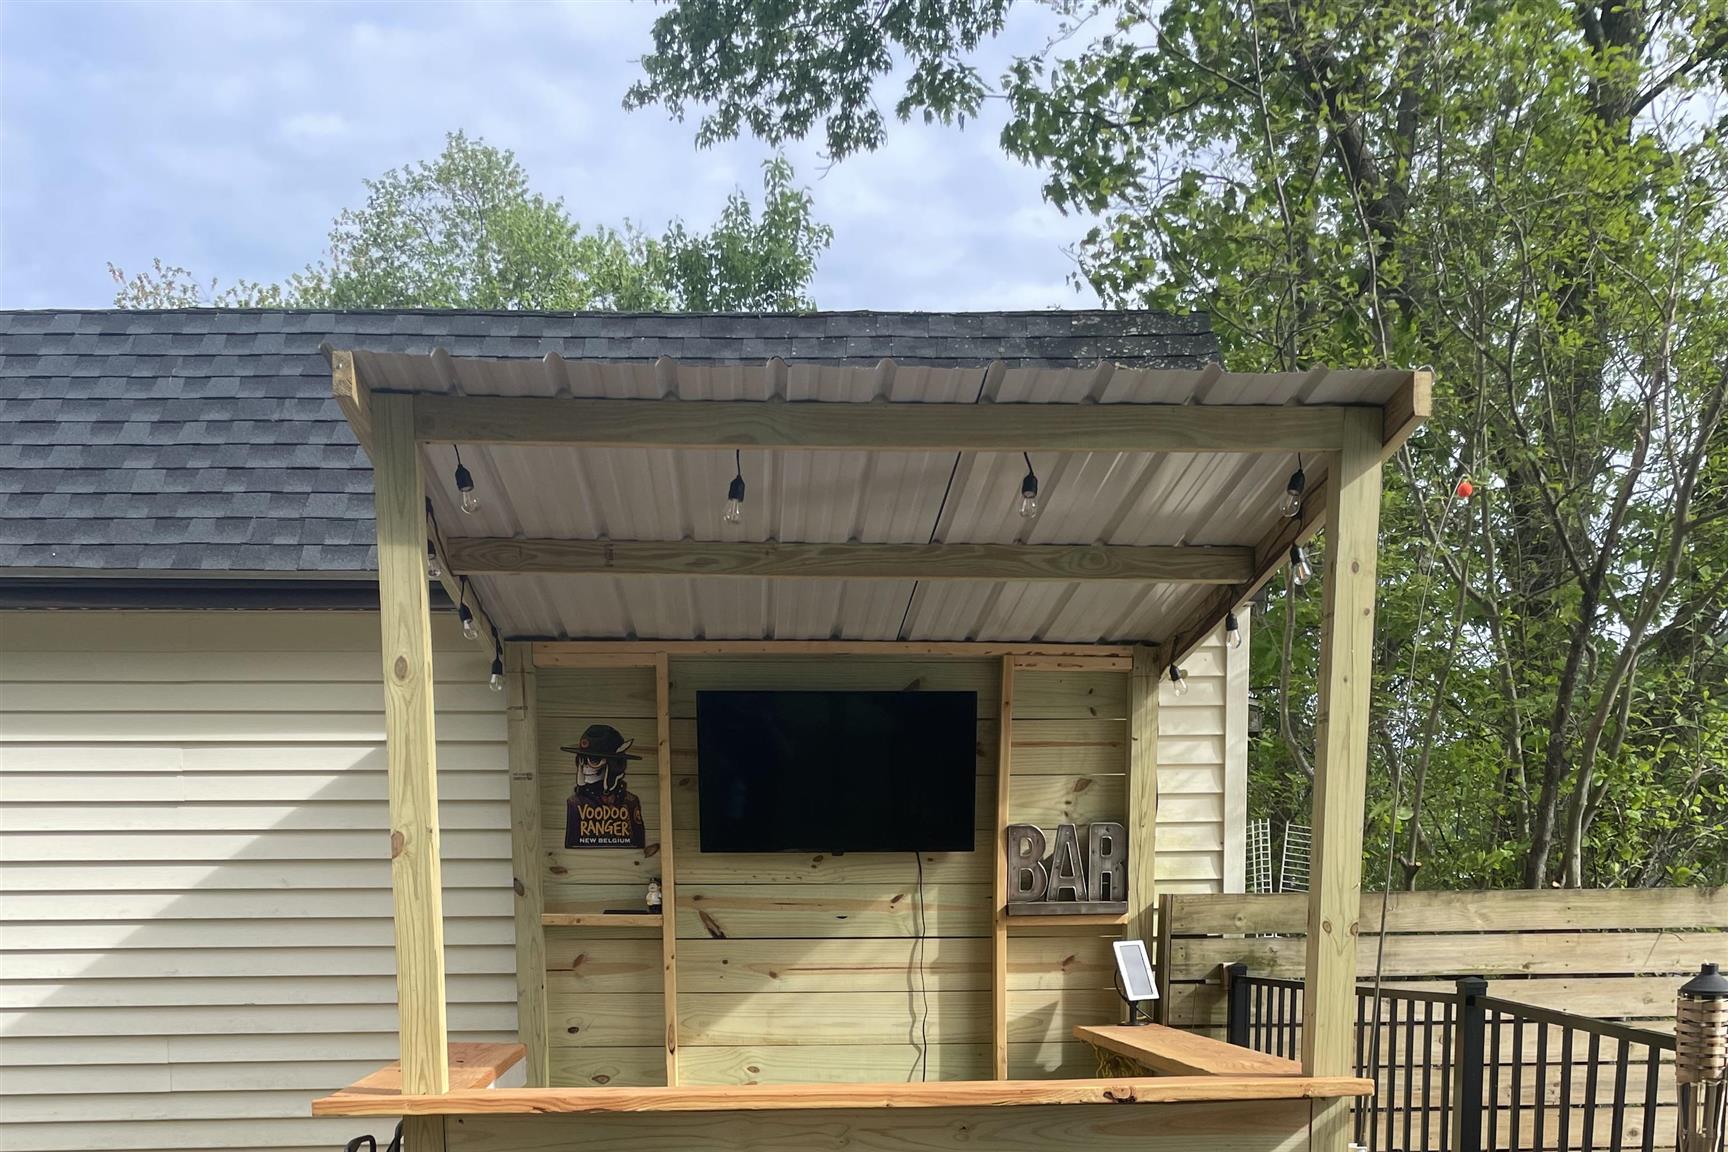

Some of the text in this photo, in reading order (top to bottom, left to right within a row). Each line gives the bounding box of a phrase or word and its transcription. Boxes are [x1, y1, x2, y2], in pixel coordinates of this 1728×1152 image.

[577, 804, 628, 820] VOODOO
[580, 820, 630, 836] RANGER
[1007, 822, 1127, 902] BAR
